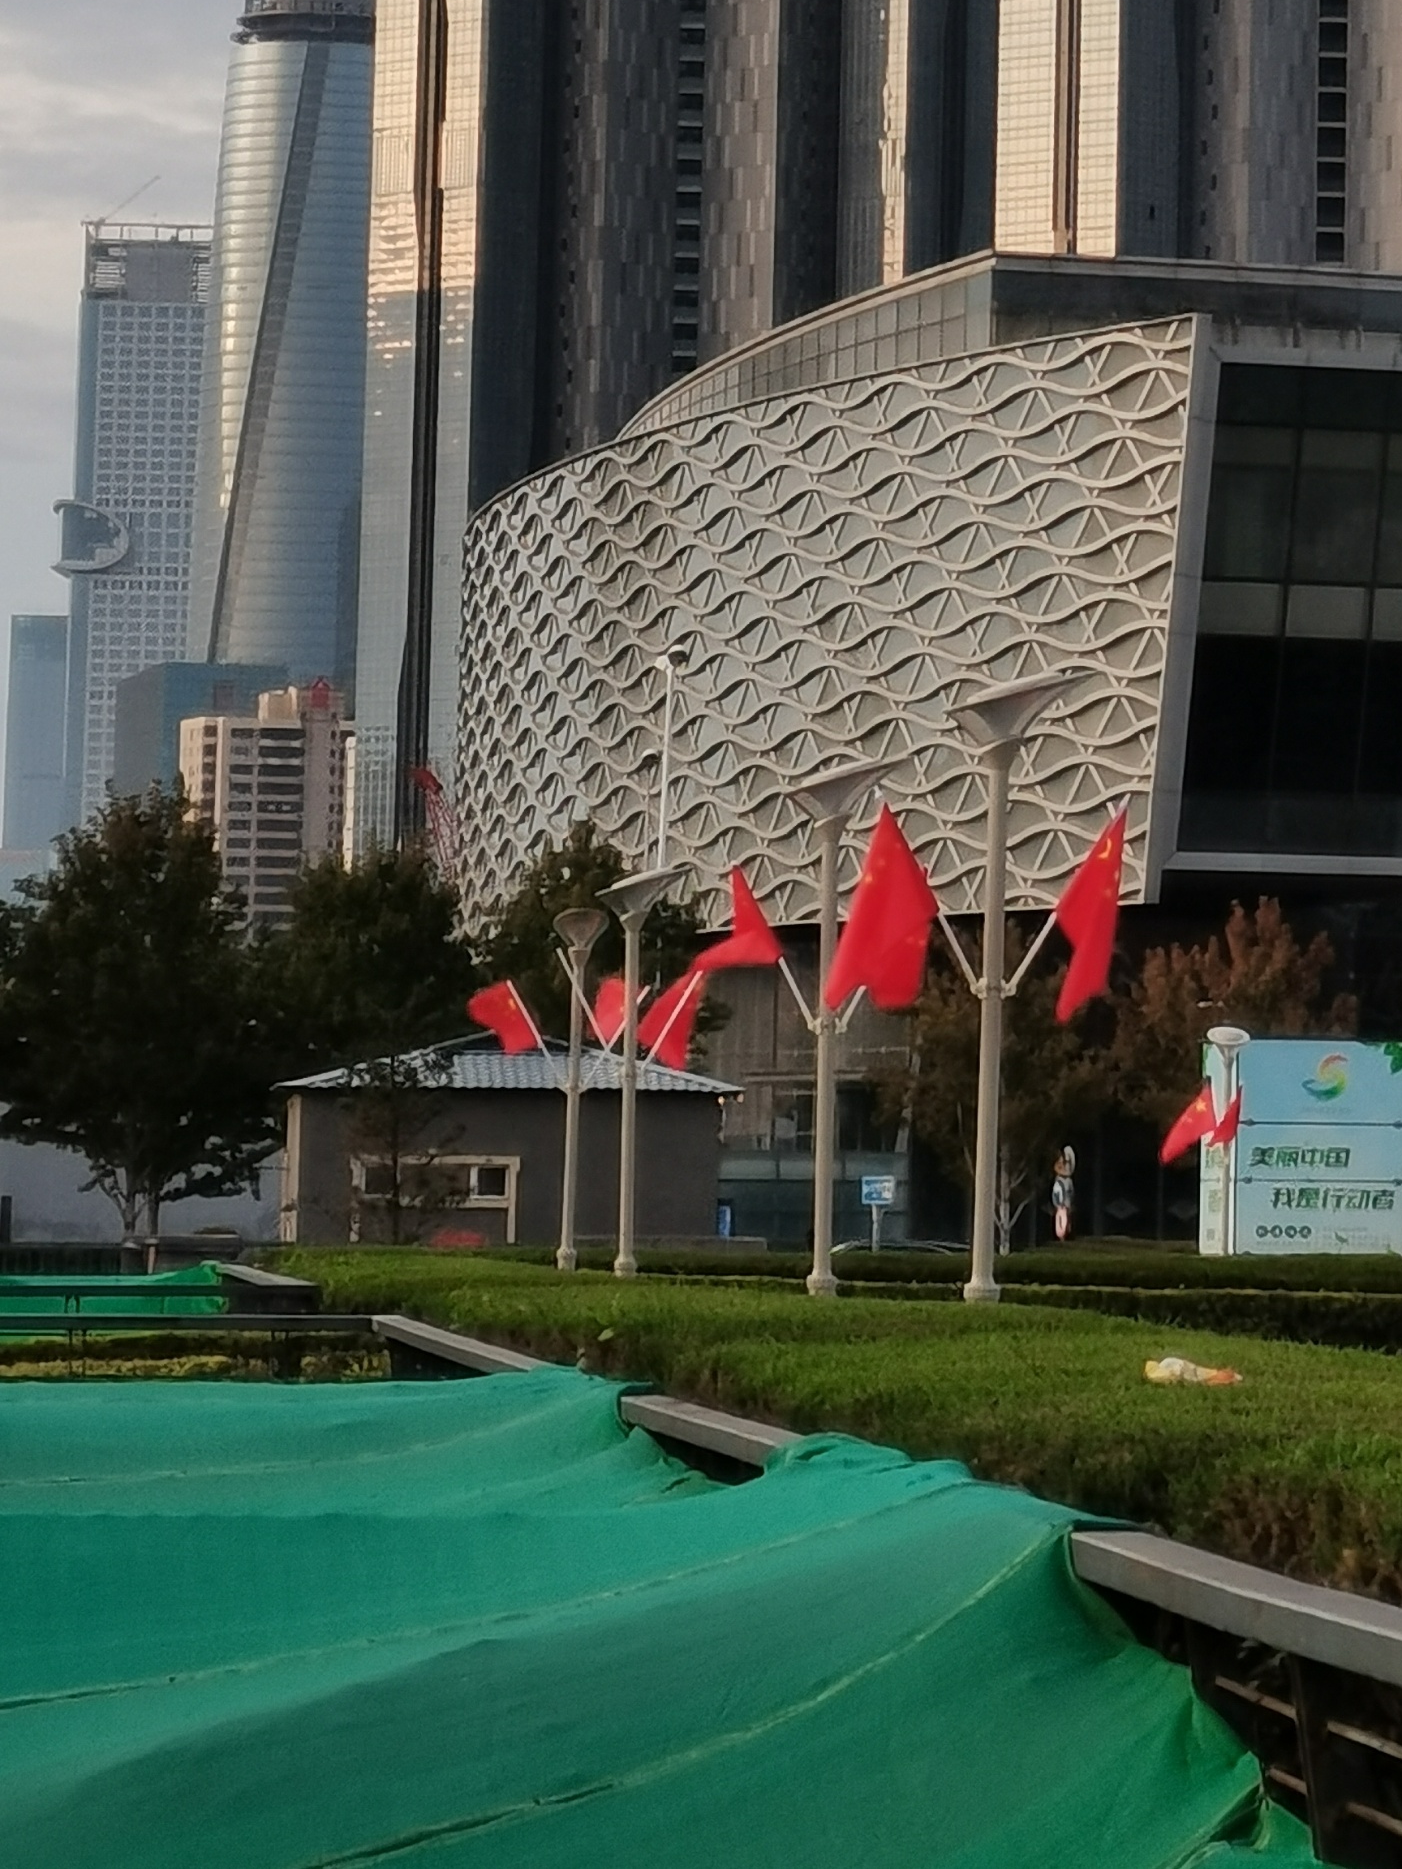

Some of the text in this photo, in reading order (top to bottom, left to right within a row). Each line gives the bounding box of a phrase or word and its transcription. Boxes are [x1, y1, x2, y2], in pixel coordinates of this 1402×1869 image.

[1249, 1146, 1350, 1168] 美丽中国
[1271, 1187, 1395, 1210] 我是行动者
